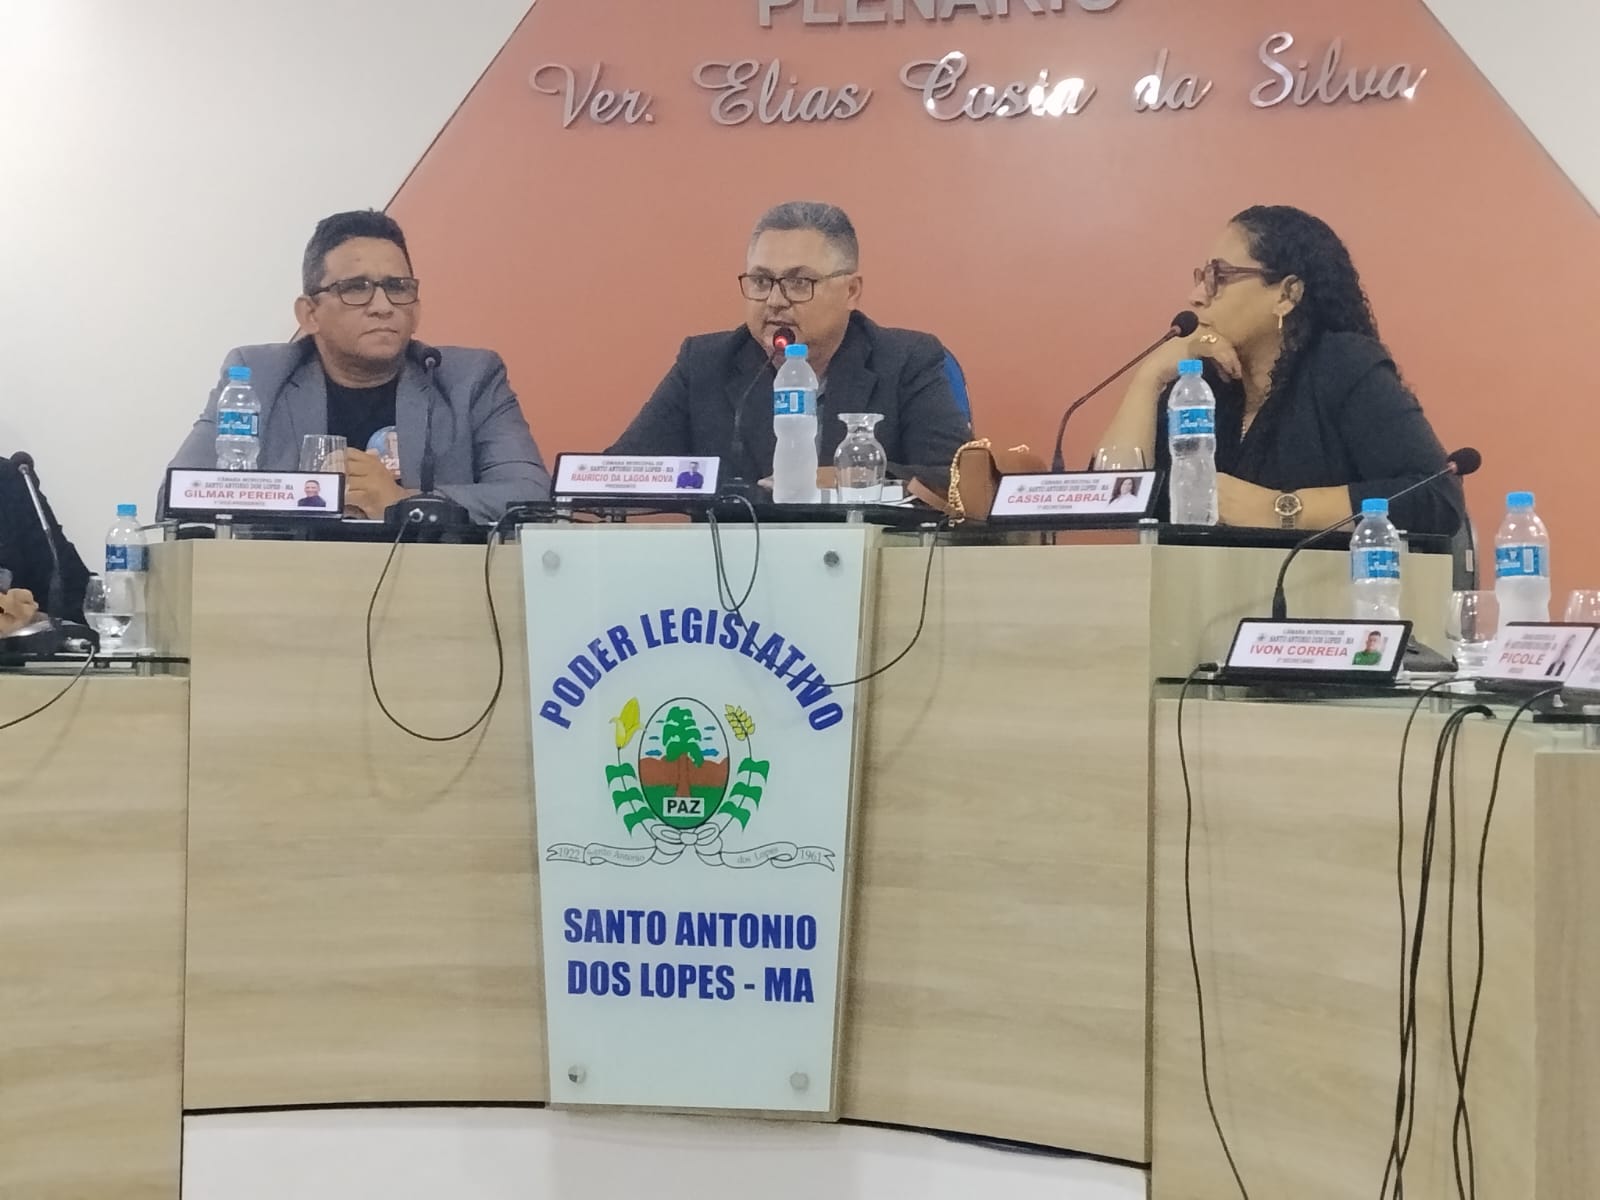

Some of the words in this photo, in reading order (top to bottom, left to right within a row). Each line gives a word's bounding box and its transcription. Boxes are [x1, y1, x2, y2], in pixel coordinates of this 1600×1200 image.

[528, 62, 656, 128] Ver.
[692, 58, 873, 126] Elias
[1133, 48, 1213, 112] da
[1250, 31, 1428, 108] Silva
[611, 473, 621, 482] DA
[623, 474, 650, 482] LAGOA
[652, 474, 673, 483] NOVA
[184, 489, 235, 499] GILMAR
[239, 490, 295, 500] PEREIRA
[1007, 494, 1053, 504] CASSIA
[1056, 493, 1109, 503] CABRAL
[1250, 645, 1284, 654] IVON
[1287, 645, 1349, 657] CORREIA
[539, 624, 638, 730] PODER
[639, 607, 844, 731] LEGISLATIVO
[667, 799, 702, 814] PAZ
[559, 847, 580, 860] 1922
[801, 849, 822, 862] 1961
[564, 907, 667, 945] SANTO
[675, 911, 817, 950] ANTONIO
[567, 960, 631, 997] DOS
[640, 963, 735, 1000] LOPES
[764, 967, 814, 1004] MA
